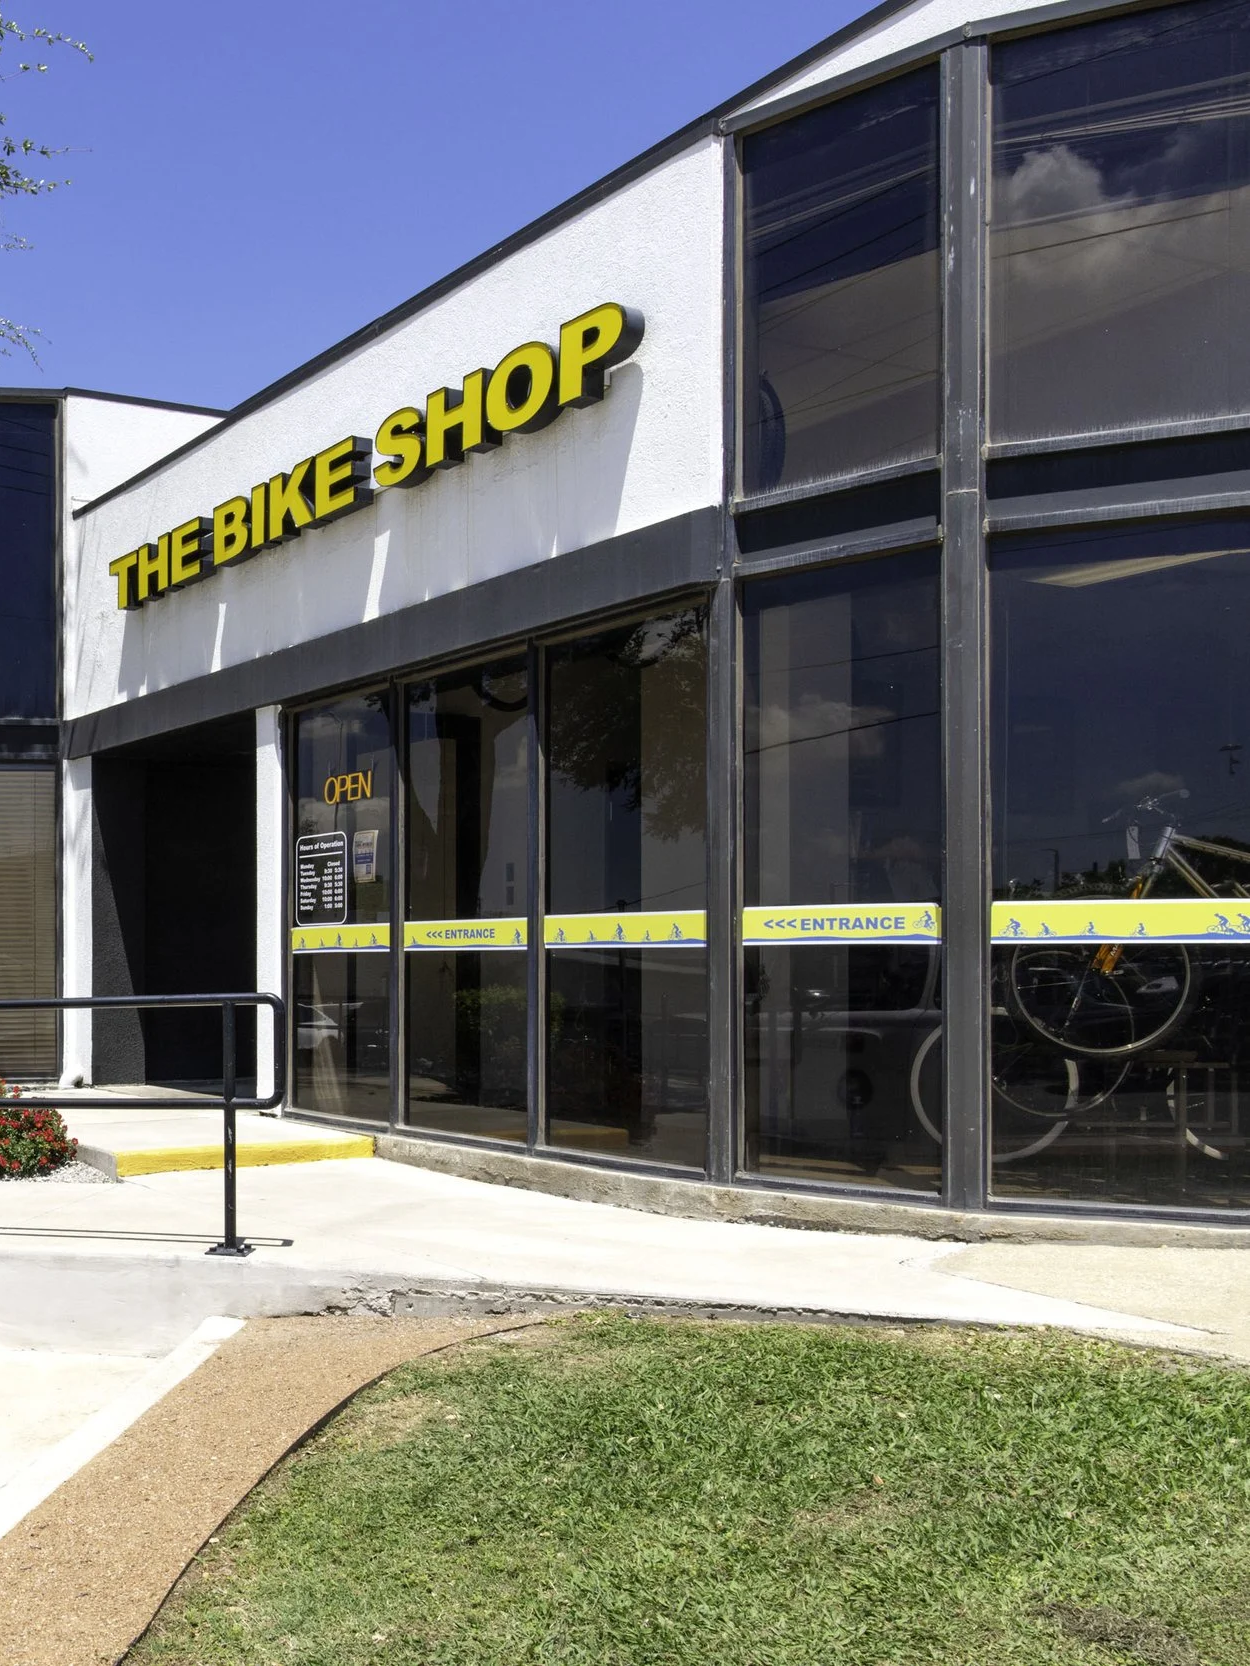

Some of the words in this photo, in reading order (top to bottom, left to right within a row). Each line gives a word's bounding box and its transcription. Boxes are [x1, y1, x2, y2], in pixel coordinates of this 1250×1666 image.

[109, 515, 210, 611] THE
[213, 435, 368, 567] BIKE
[373, 302, 636, 488] SHOP
[324, 770, 372, 805] OPEN
[299, 844, 313, 852] Hours
[314, 842, 319, 850] of
[320, 840, 344, 850] Operation
[800, 916, 905, 931] ENTRANCE
[445, 928, 495, 939] ENTRANCE
